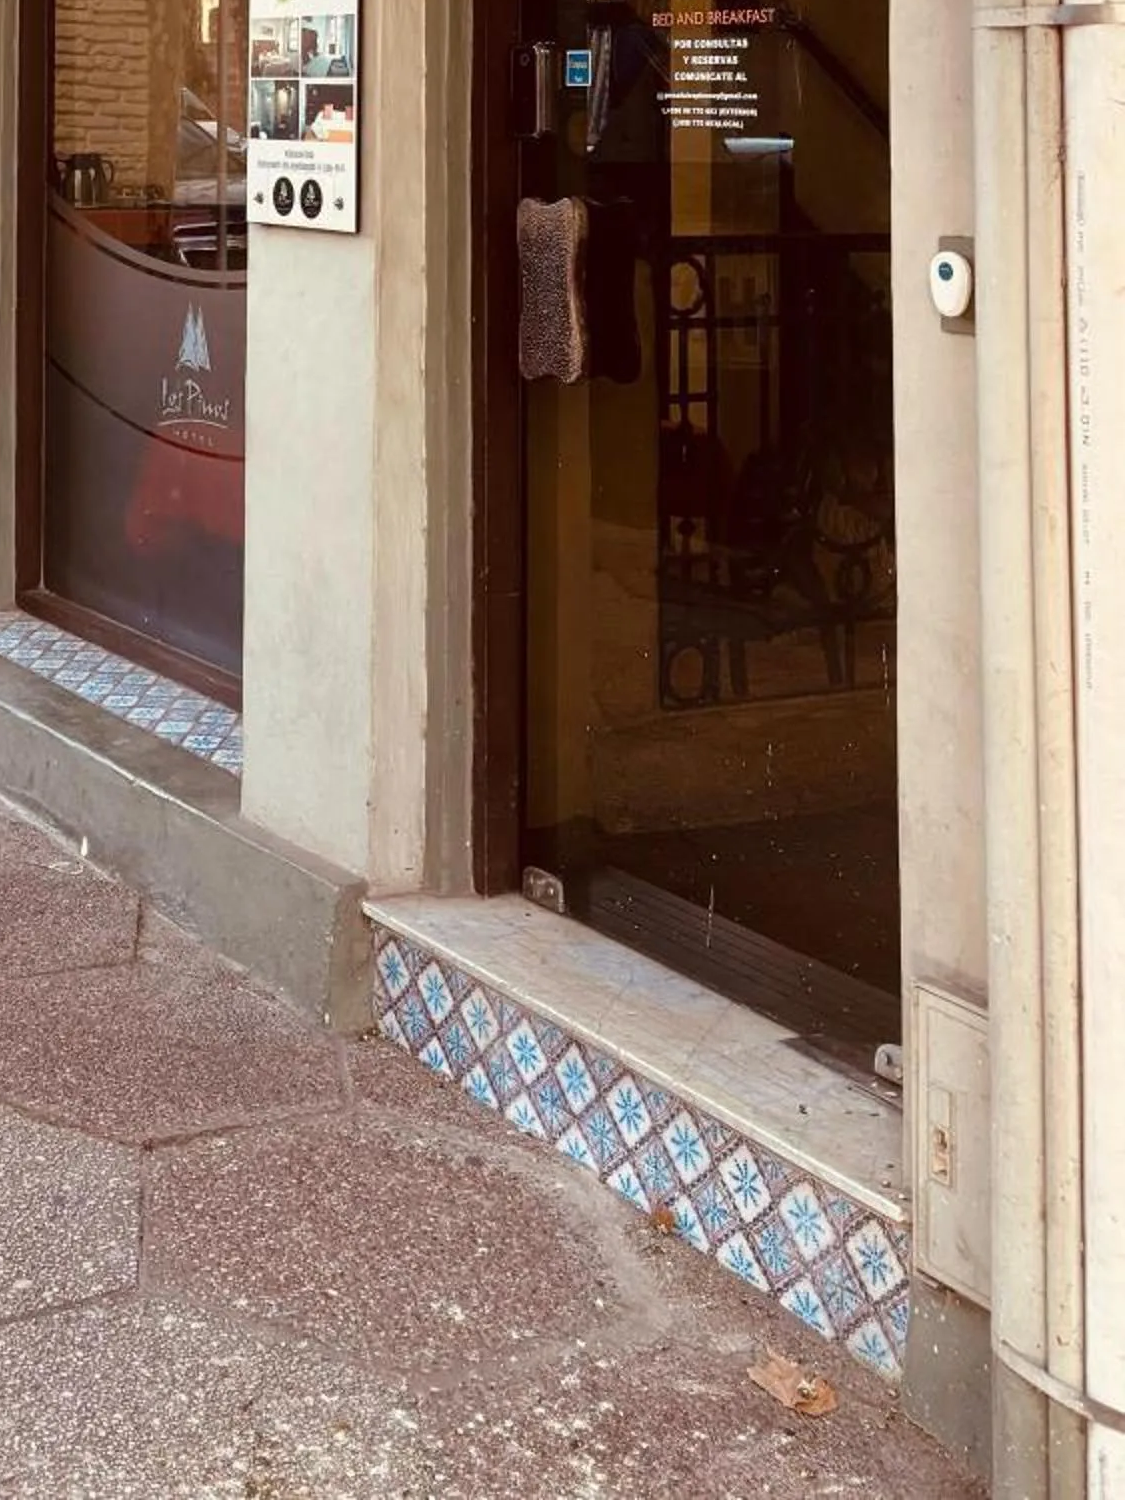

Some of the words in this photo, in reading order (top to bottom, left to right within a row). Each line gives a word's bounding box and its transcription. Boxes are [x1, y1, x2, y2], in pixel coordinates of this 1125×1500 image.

[652, 13, 674, 27] BED
[676, 11, 704, 25] AND
[706, 8, 775, 25] BREAKFAST
[674, 39, 692, 49] POR
[694, 38, 748, 49] CONSULTAS
[682, 55, 690, 65] Y
[691, 55, 738, 65] RESERVAS
[735, 71, 748, 81] AL
[162, 377, 184, 415] Los
[185, 379, 230, 421] Pinos
